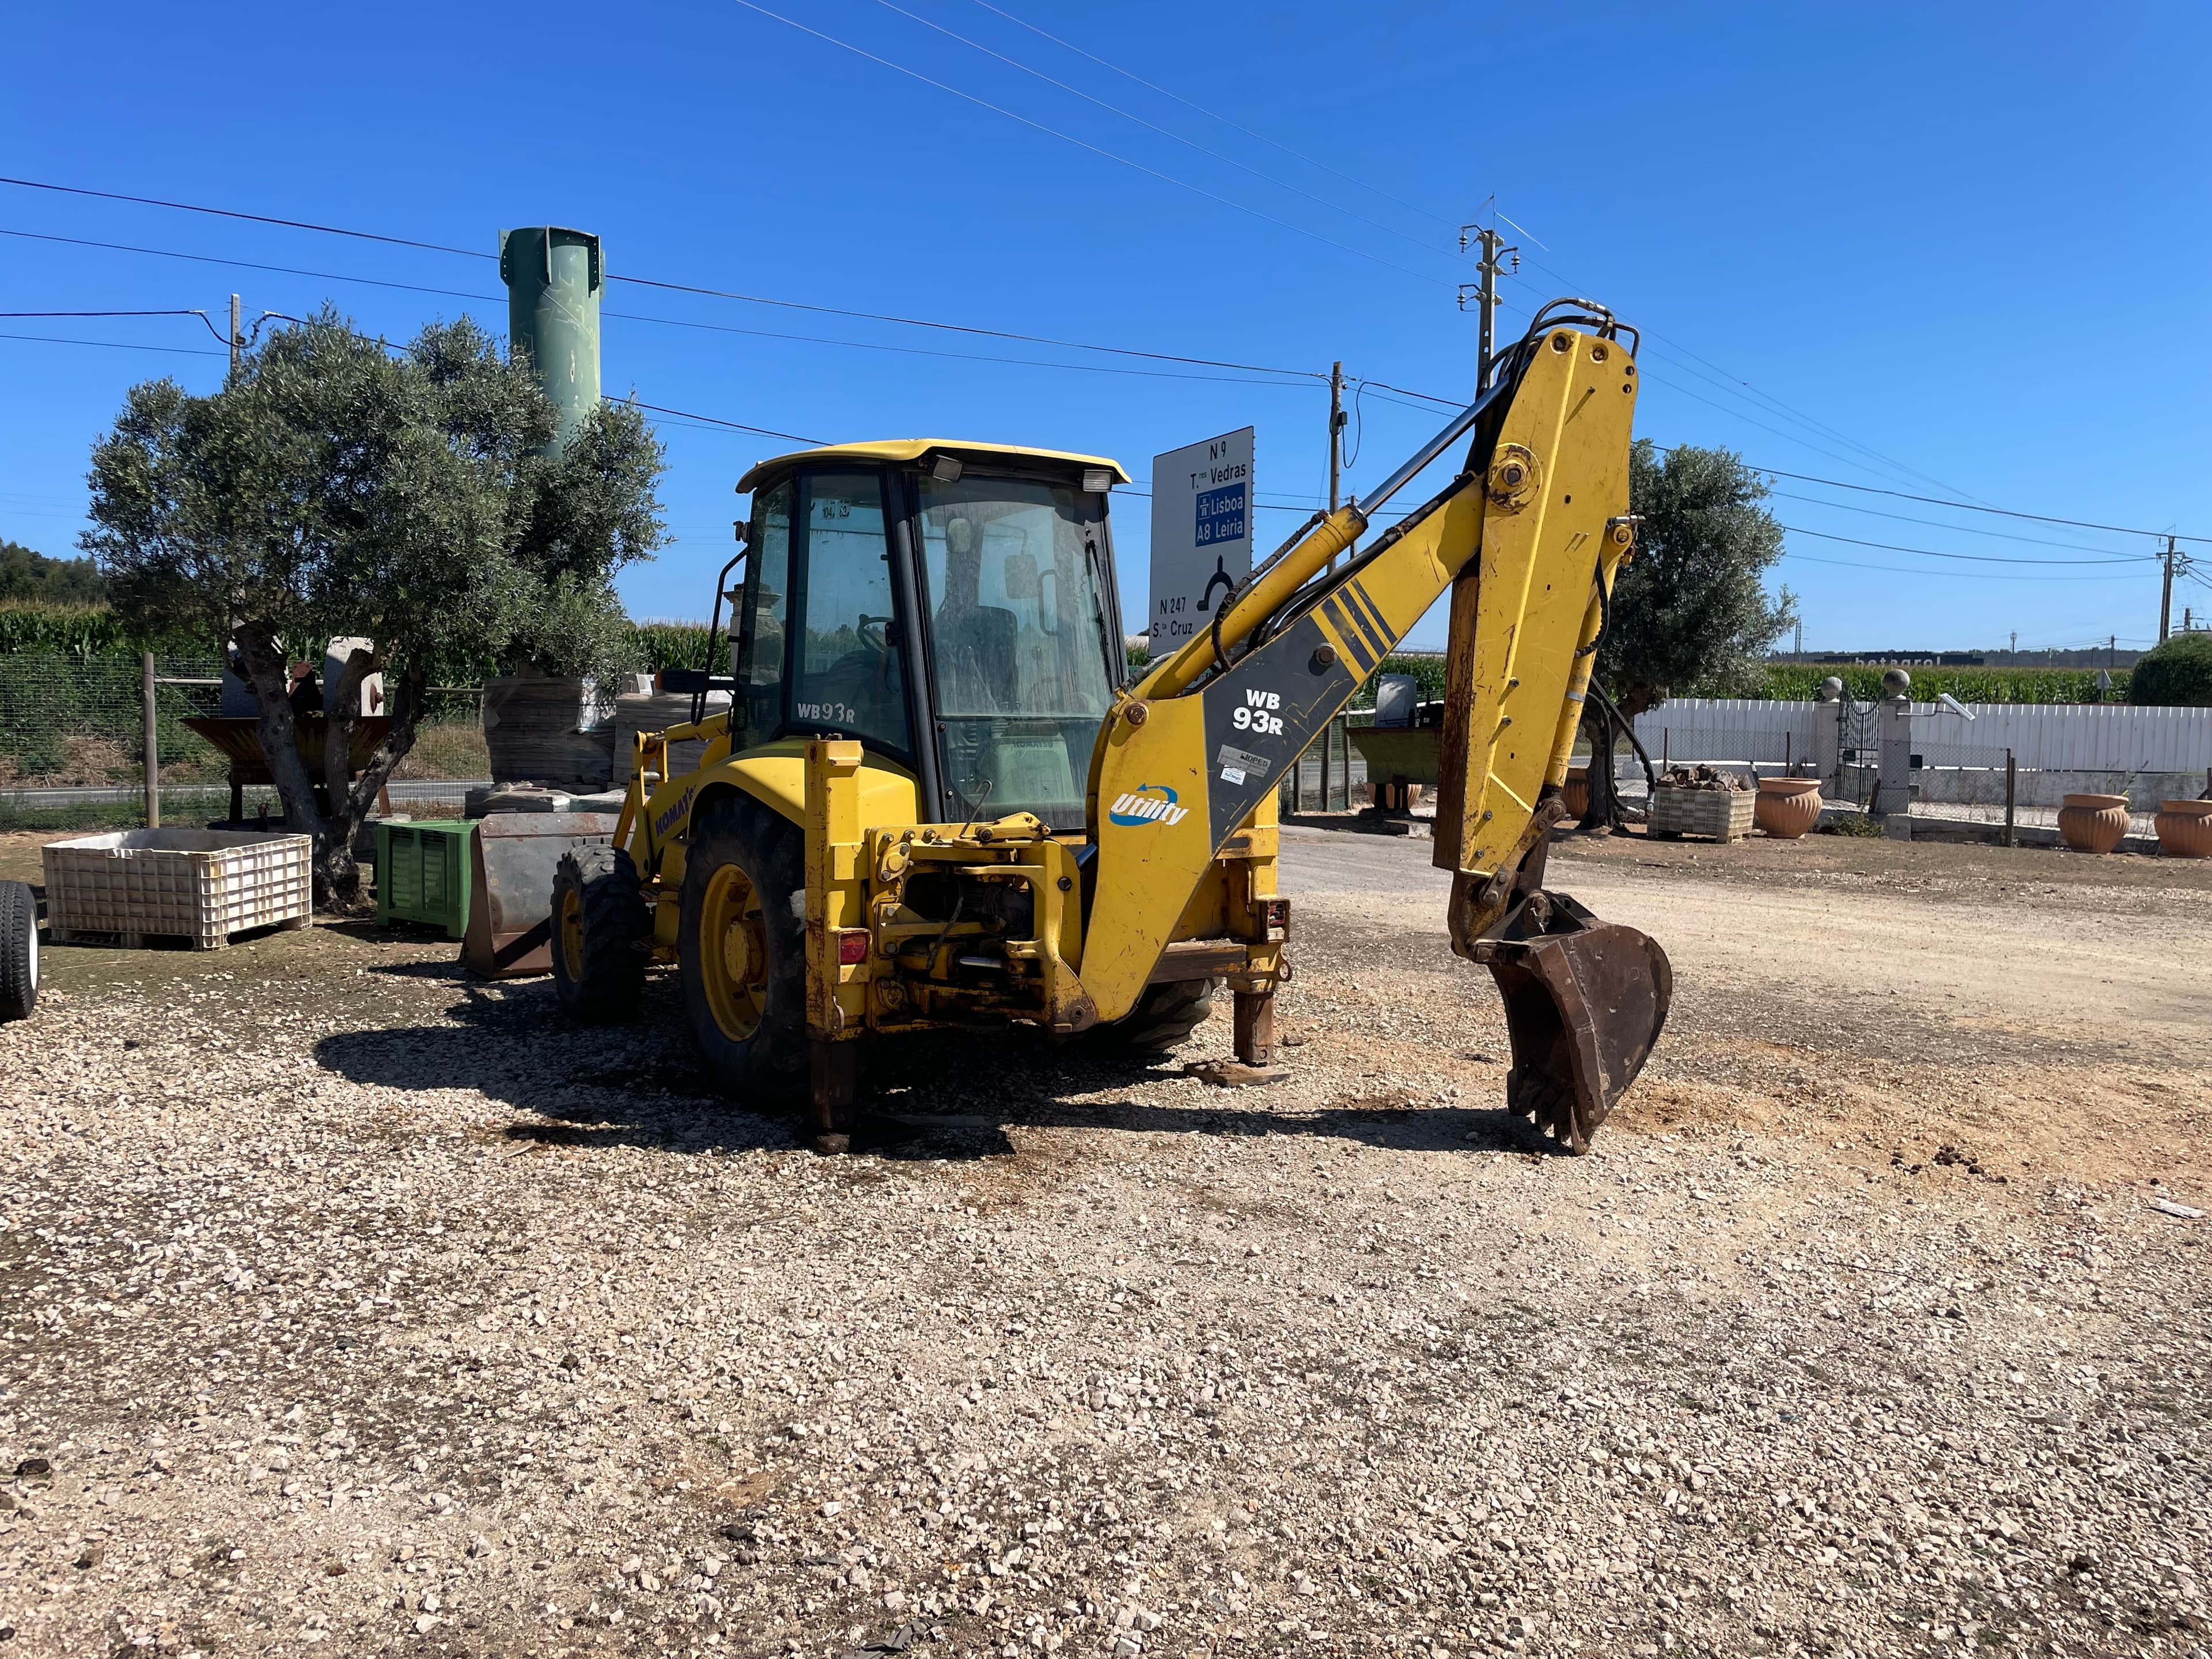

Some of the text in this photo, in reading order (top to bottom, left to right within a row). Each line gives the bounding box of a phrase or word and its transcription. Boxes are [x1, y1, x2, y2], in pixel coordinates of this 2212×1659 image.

[1210, 441, 1226, 461] N 9
[1210, 463, 1246, 484] Vedras
[1211, 495, 1243, 516] Lisboa
[1196, 517, 1243, 542] A8 Leiria
[1160, 597, 1186, 615] N 247
[1171, 620, 1193, 636] Cruz
[1246, 688, 1280, 710] WB
[1233, 707, 1283, 736] 93R
[1111, 793, 1190, 825] Utility
